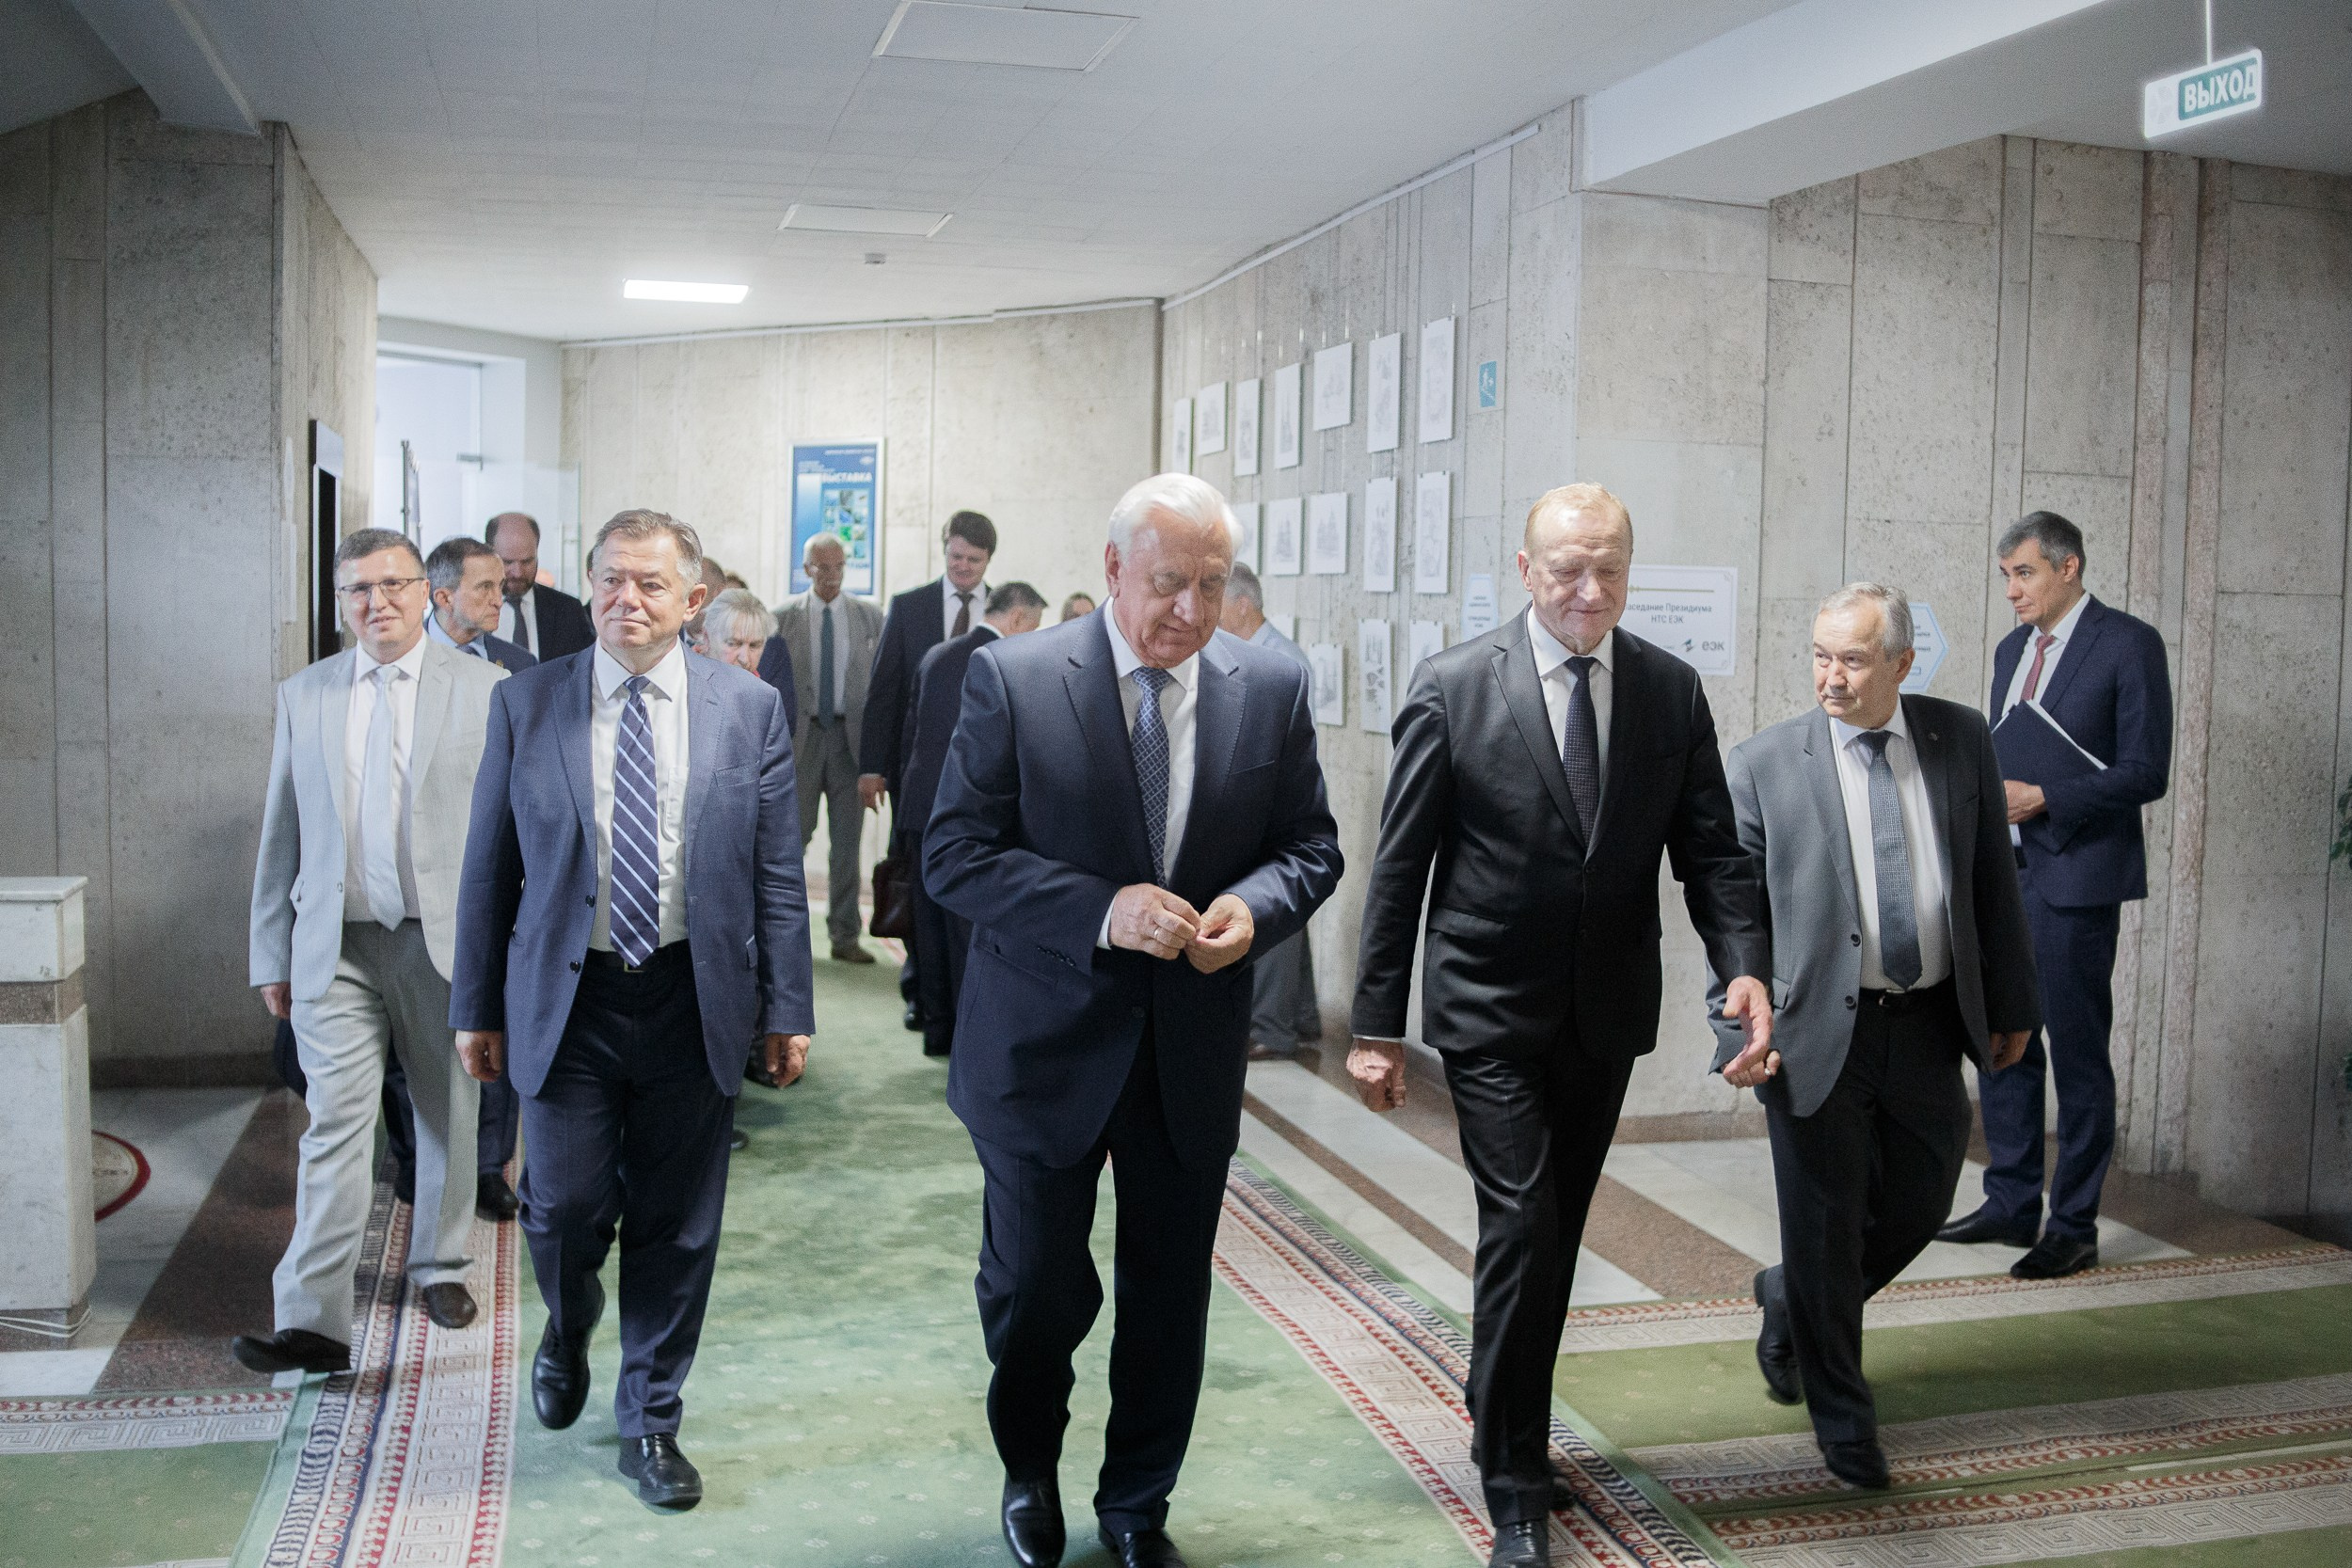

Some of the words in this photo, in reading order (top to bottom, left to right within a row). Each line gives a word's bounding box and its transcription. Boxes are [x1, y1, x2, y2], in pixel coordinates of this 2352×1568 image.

[2184, 64, 2258, 113] ВЫХОД
[1625, 604, 1664, 612] аседание
[1665, 603, 1712, 613] Президиума
[1651, 614, 1667, 623] НТС
[1668, 614, 1684, 624] ЕЭК
